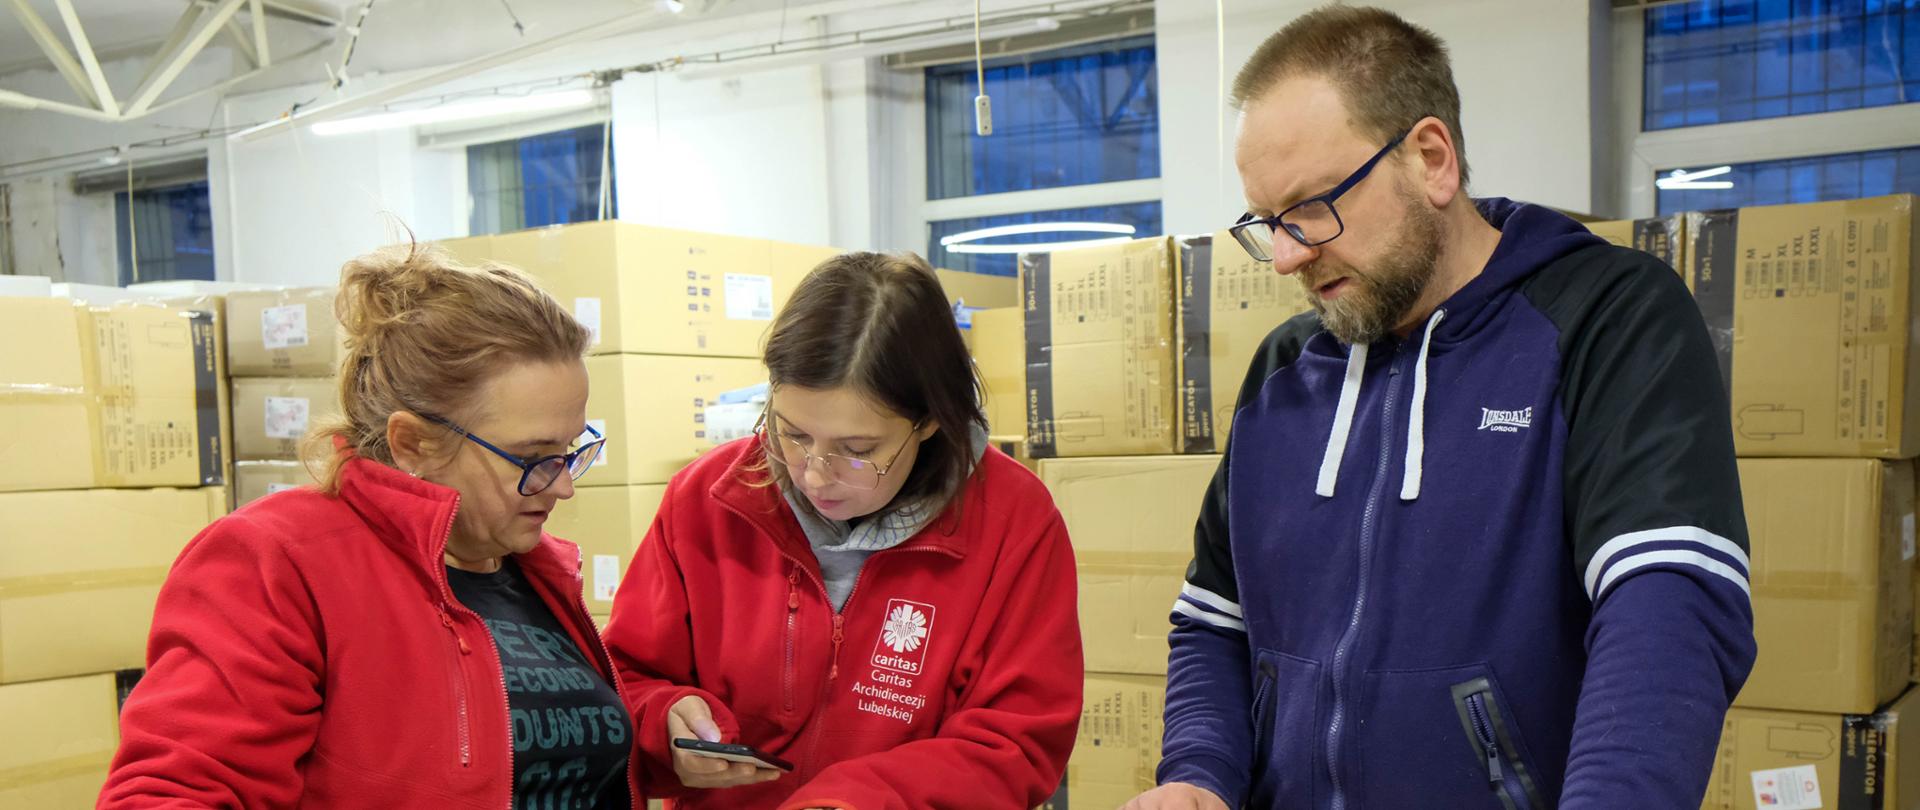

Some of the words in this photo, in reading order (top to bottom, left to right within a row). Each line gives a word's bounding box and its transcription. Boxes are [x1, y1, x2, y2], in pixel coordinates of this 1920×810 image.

[1777, 244, 1788, 257] XL
[1793, 235, 1804, 256] XXL
[1809, 226, 1820, 255] XXXL
[1746, 249, 1756, 259] M
[1187, 379, 1196, 437] MERCATOR
[1478, 406, 1532, 430] LONSDALE
[486, 619, 583, 663] ERY
[875, 654, 917, 672] caritas
[504, 665, 595, 692] ECOND
[871, 669, 912, 688] Caritas
[852, 681, 926, 709] Archidiecezji
[858, 699, 914, 724] Lubelskiej
[512, 705, 625, 751] OUNTS
[1864, 727, 1877, 794] MERCATOR
